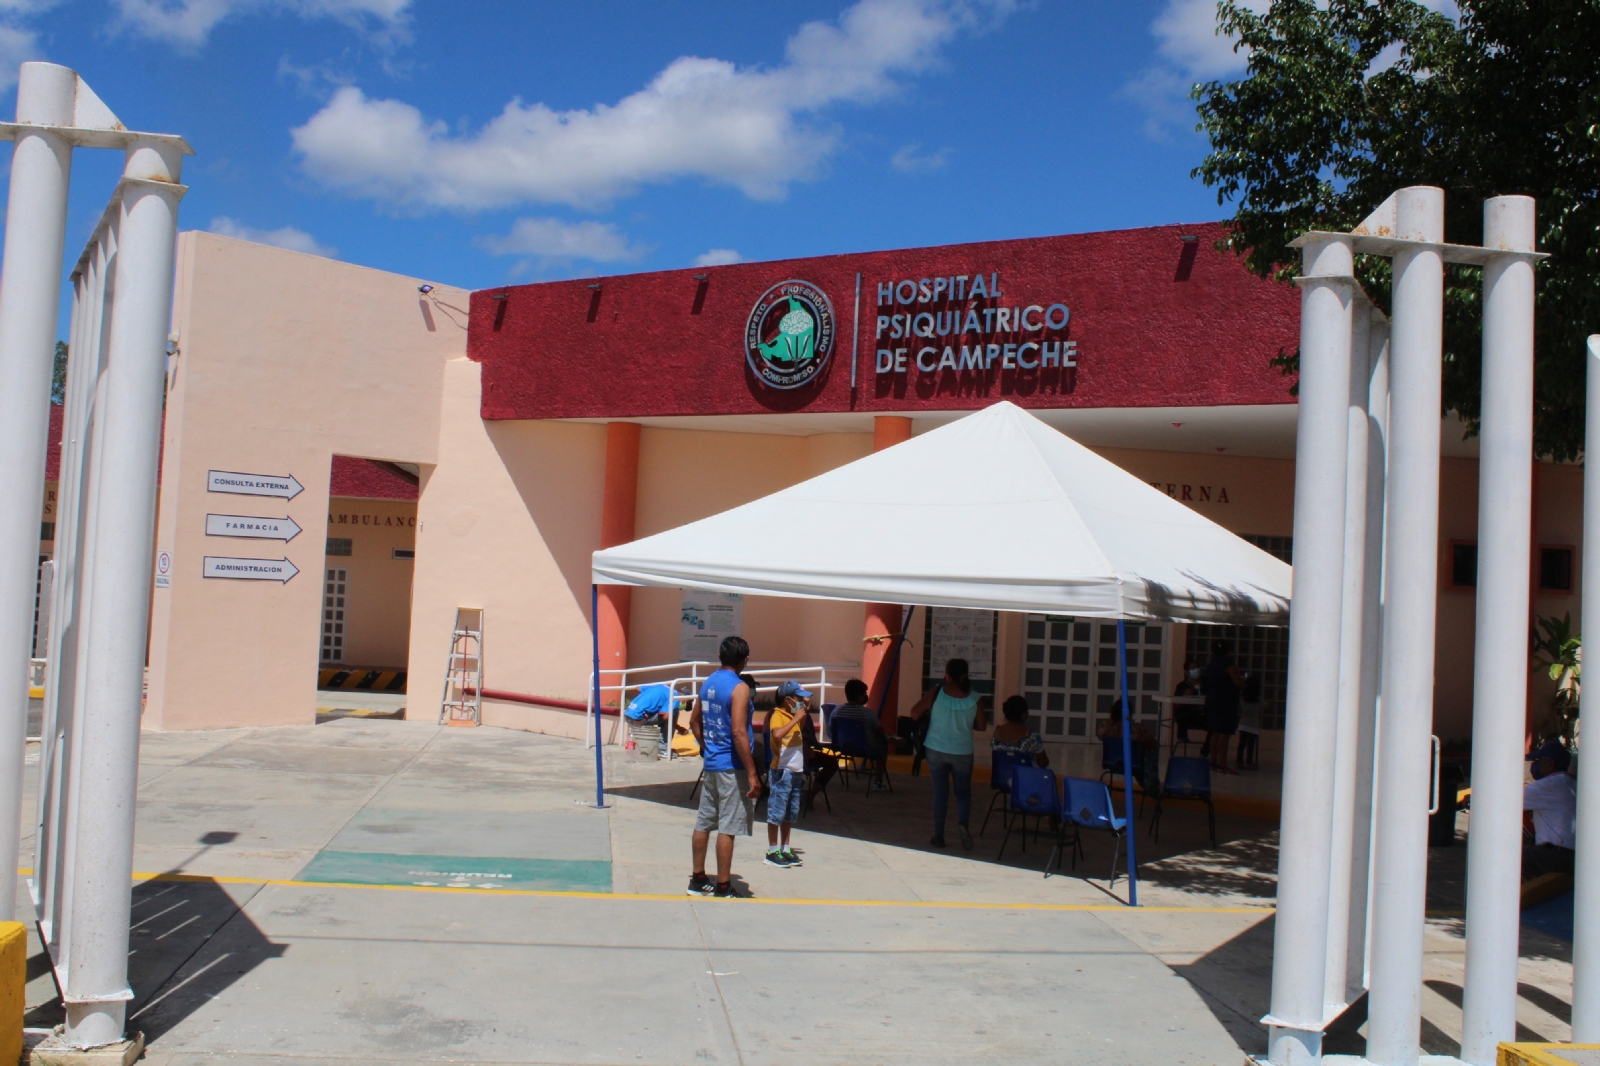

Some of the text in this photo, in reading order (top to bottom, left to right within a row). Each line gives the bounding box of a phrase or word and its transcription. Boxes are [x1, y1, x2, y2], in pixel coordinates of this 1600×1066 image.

[877, 272, 1003, 306] HOSPITAL
[749, 303, 768, 350] RESPETO
[781, 285, 831, 352] PROFESIONALISMO
[875, 302, 1070, 339] PSIQUIÁTRICO
[875, 341, 1077, 374] DE CAMPECHE
[762, 365, 814, 384] COMPROMISO
[214, 478, 289, 490] CONSULTA EXTERNA
[226, 522, 279, 531] FARMACIA
